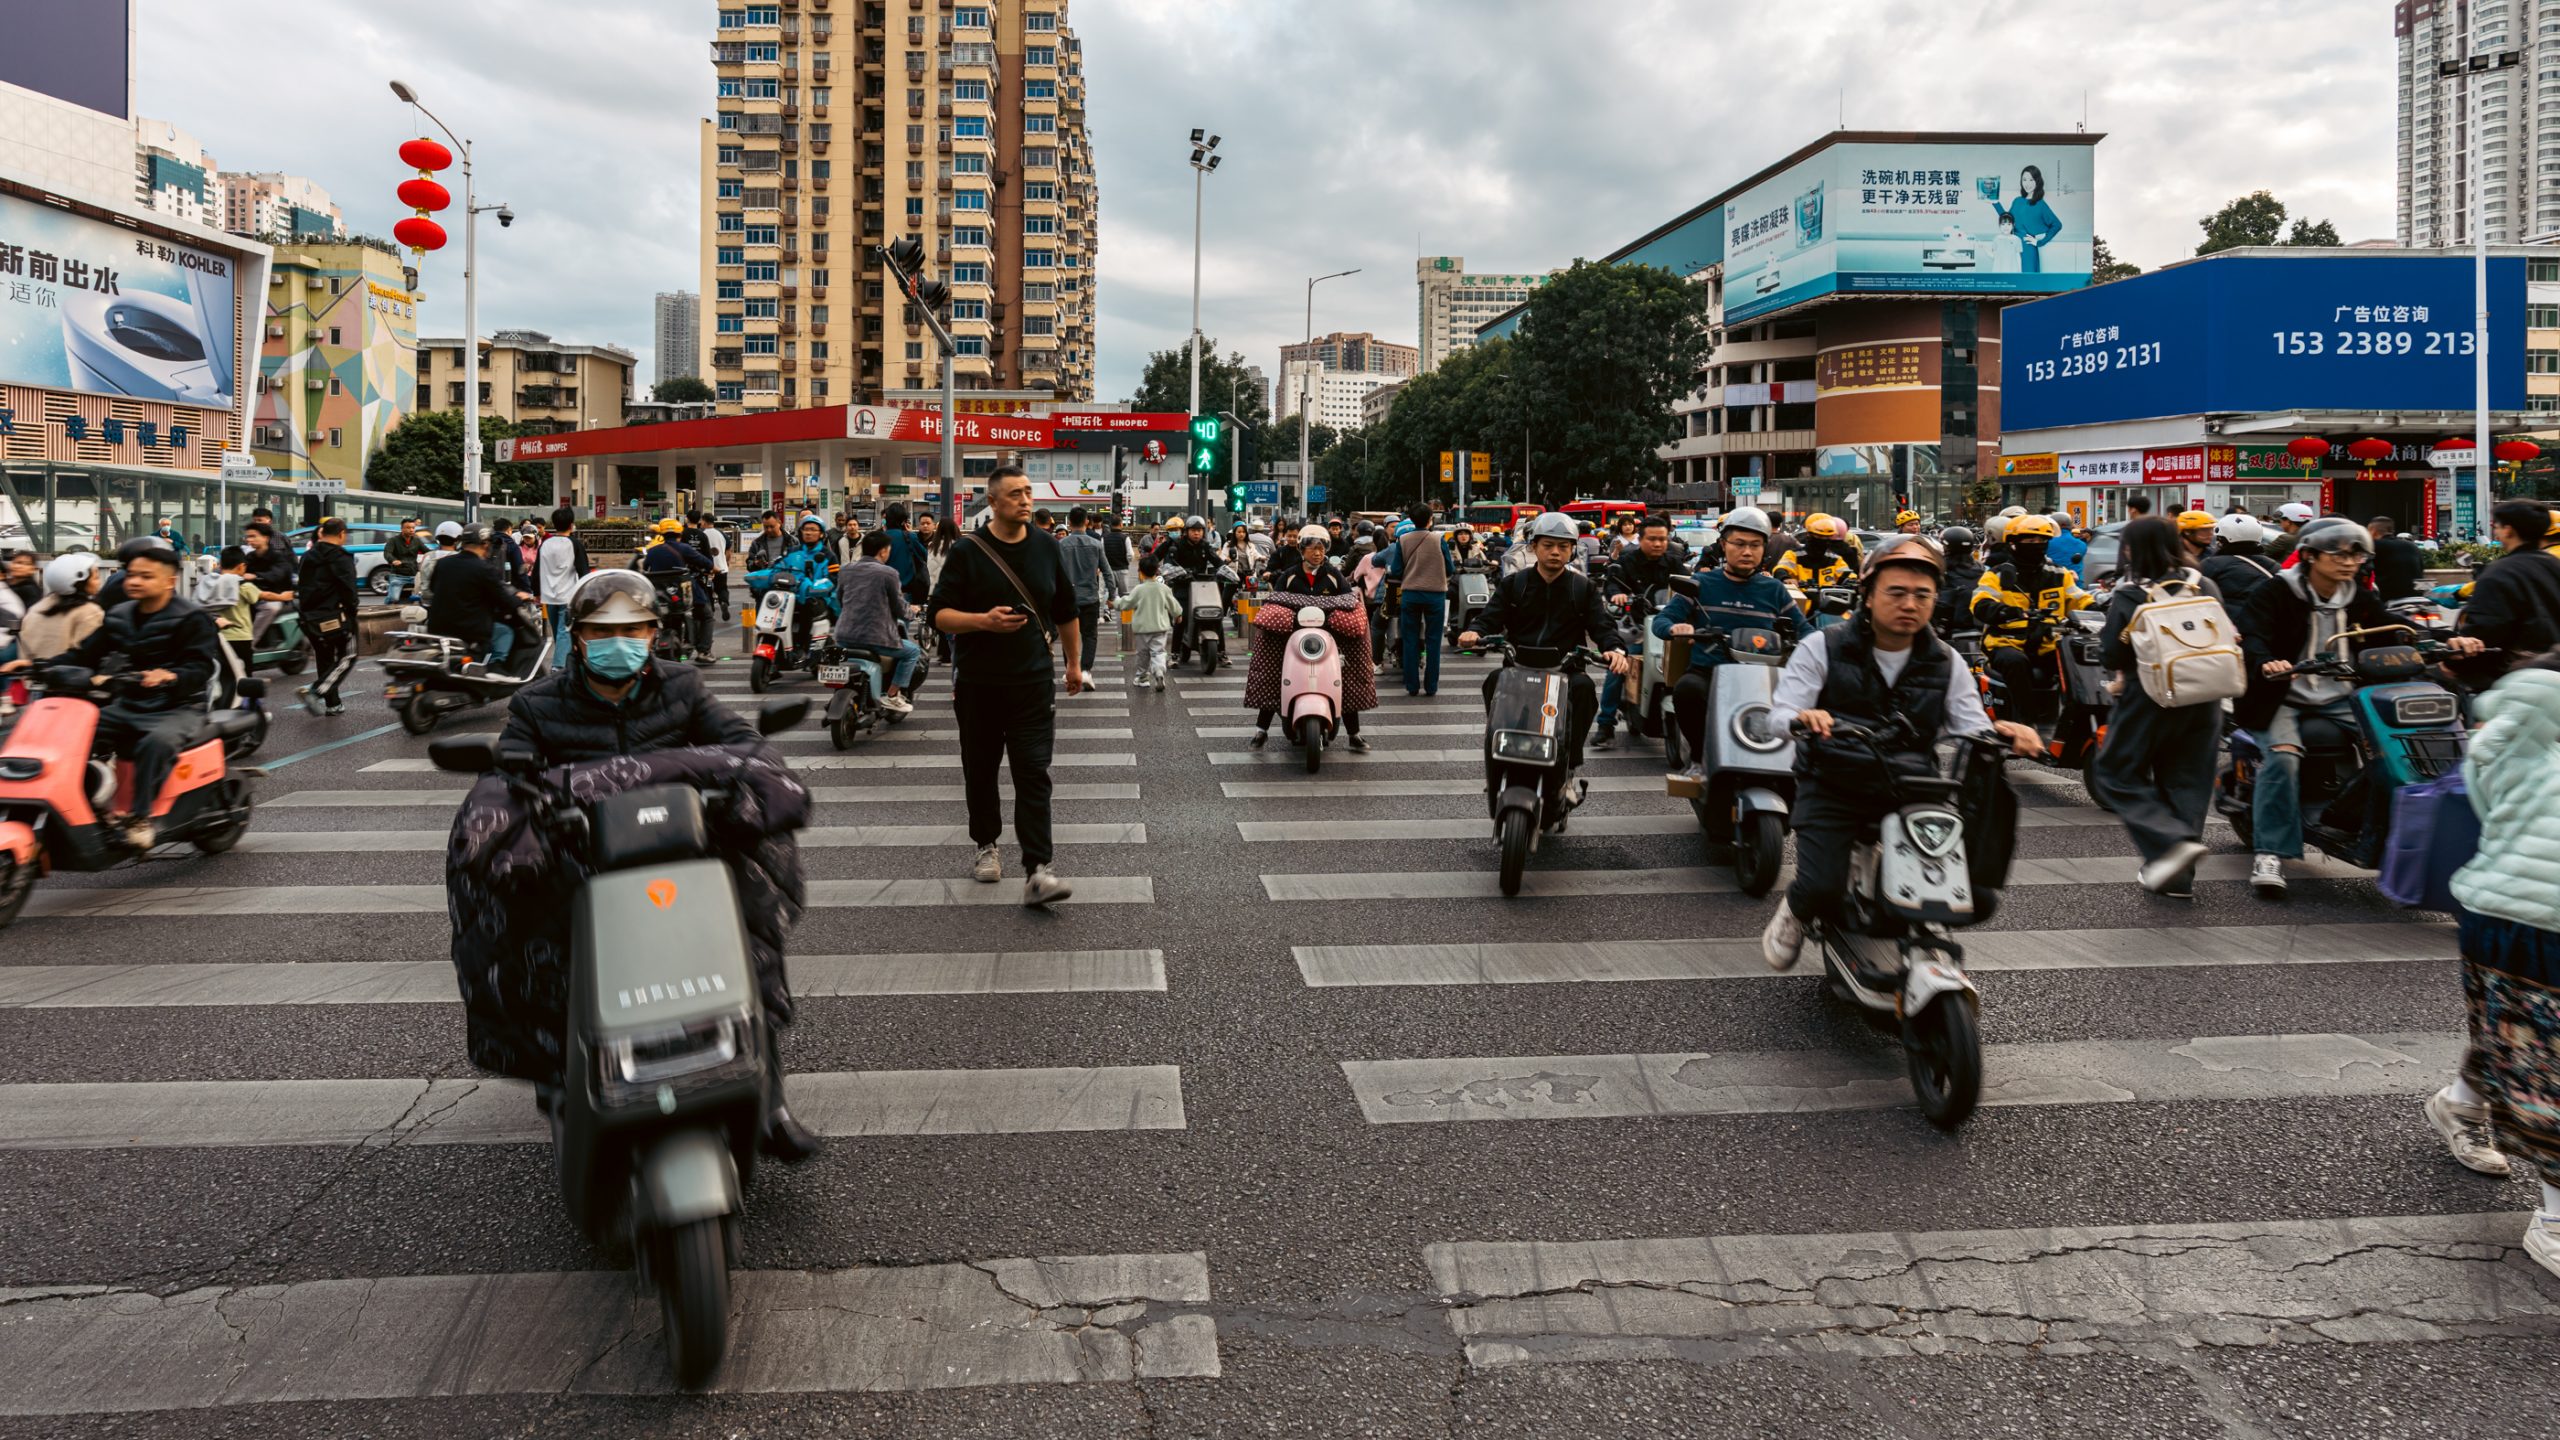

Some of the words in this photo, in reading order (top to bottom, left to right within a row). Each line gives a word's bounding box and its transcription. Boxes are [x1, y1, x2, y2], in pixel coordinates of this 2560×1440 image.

[1862, 169, 1960, 186] 洗碗机用亮碟
[1732, 205, 1789, 247] 亮碟洗碗凝珠
[136, 240, 175, 264] 科勒
[179, 251, 226, 277] KOHLER
[0, 281, 56, 308] 适你
[2334, 305, 2429, 323] 广告位咨询
[2060, 325, 2120, 350] 广告位咨询
[2273, 332, 2323, 355] 153
[2336, 331, 2412, 355] 2389
[2424, 331, 2490, 355] 213
[1880, 347, 1896, 356] 文明
[1902, 345, 1919, 354] 和谐
[1858, 359, 1873, 367] 平等
[1879, 357, 1896, 365] 公正
[1902, 355, 1919, 364] 法治
[2026, 361, 2055, 383] 153
[2062, 350, 2109, 376] 2389
[2117, 341, 2161, 369] 2131
[1859, 368, 1874, 377] 敬业
[1879, 367, 1896, 375] 诚信
[1901, 366, 1919, 374] 友善
[1062, 415, 1103, 427] 中国石化
[1110, 419, 1149, 427] SINOPEC
[66, 415, 187, 448] 幸福福田
[990, 427, 1042, 442] SINOPEC
[1196, 422, 1216, 439] 40
[546, 442, 568, 453] SINOPEC
[1053, 439, 1080, 449] KFC
[2157, 453, 2202, 471] 中国福利彩票
[2210, 448, 2234, 462] 体彩
[2079, 461, 2140, 476] 中国体育彩票
[2210, 464, 2234, 479] 福彩
[1234, 486, 1245, 496] 40
[1247, 484, 1276, 492] 人行隧道
